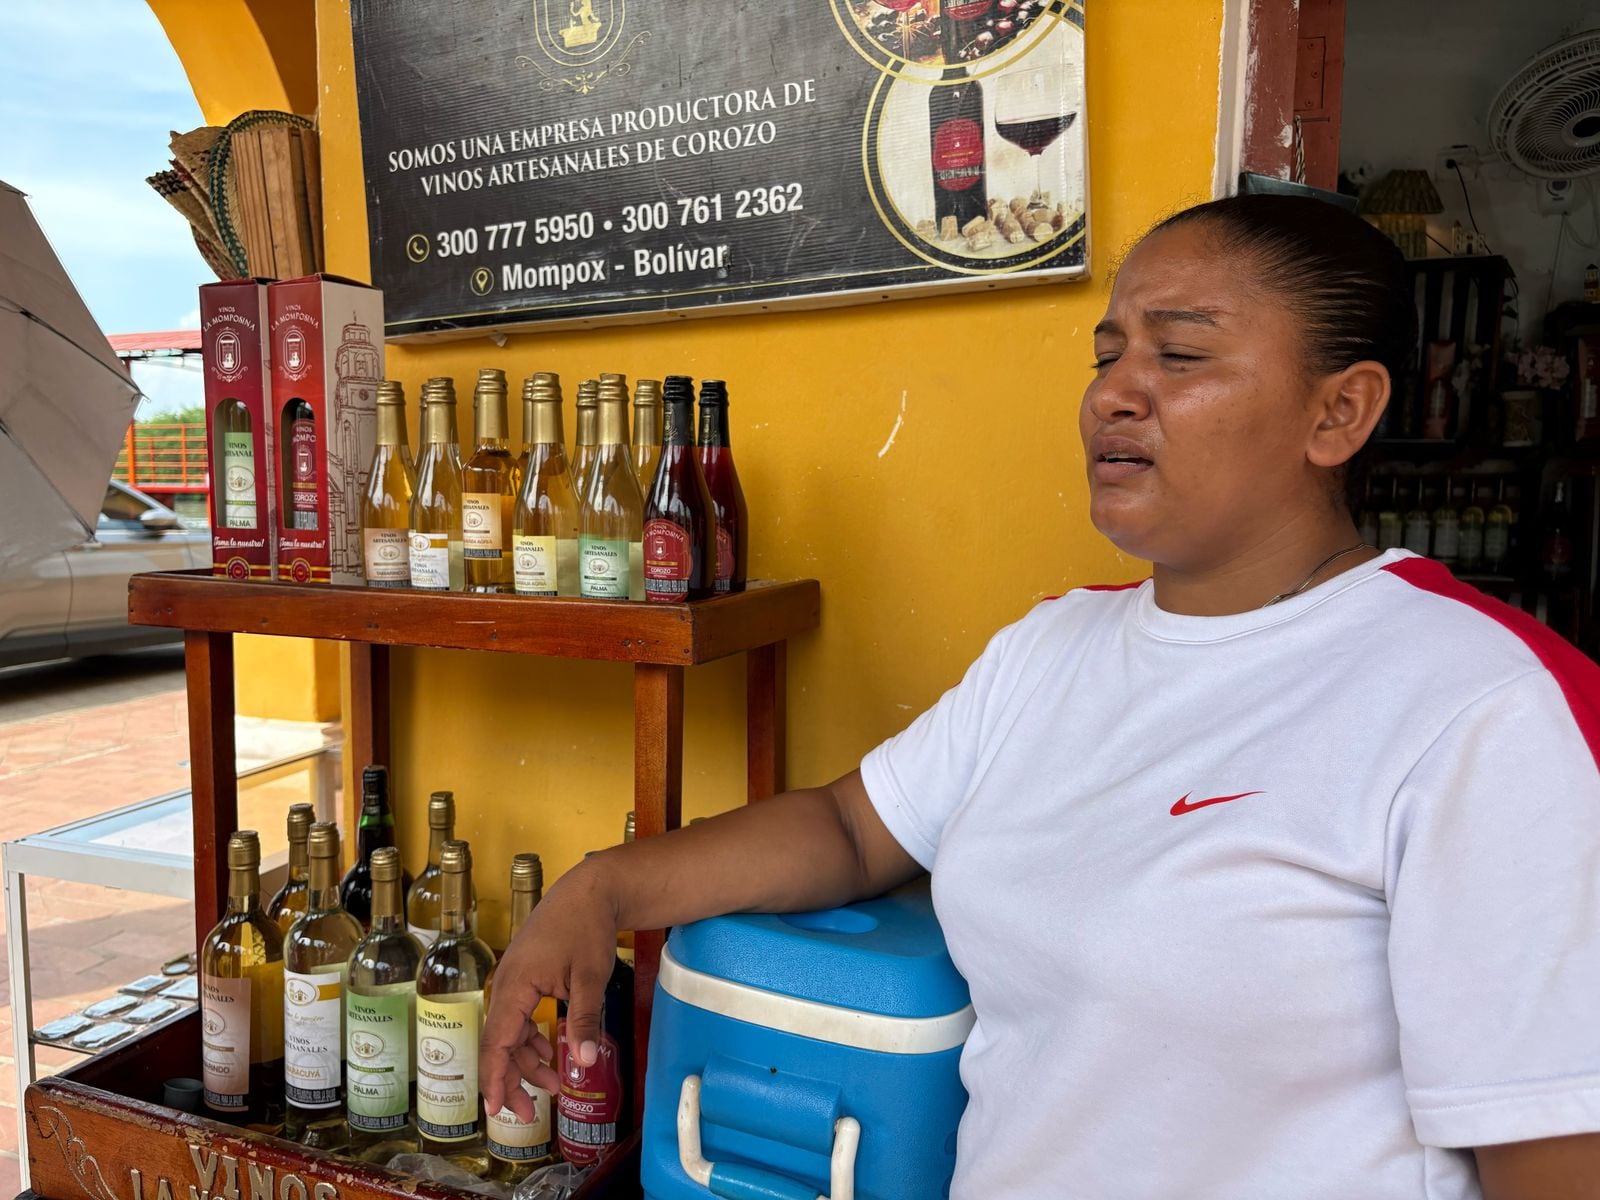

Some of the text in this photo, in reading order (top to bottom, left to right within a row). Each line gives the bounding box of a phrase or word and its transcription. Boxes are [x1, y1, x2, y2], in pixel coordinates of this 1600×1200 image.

[388, 79, 816, 172] SOMOS UNA EMPRESA PRODUCTORA DE
[421, 120, 777, 196] VINOS ARTESANALES DE COROZO
[437, 228, 478, 258] 300
[485, 221, 527, 252] 777
[534, 212, 594, 245] 5950
[621, 203, 669, 233] 300
[676, 195, 723, 227] 761
[735, 183, 804, 219] 2362
[502, 259, 605, 291] Mompox
[634, 243, 728, 278] Bolívar
[285, 304, 302, 312] VINOS
[203, 313, 256, 332] LA MOMPOSINA
[271, 312, 319, 331] LA MOMPOSINA
[229, 519, 251, 527] PALMA
[650, 567, 672, 575] COROZO
[354, 1004, 376, 1014] VINOS
[423, 1009, 447, 1021] VINOS
[348, 1010, 393, 1023] RTESANALES
[289, 1034, 311, 1045] VINOS
[353, 1084, 379, 1096] PALMA
[560, 1096, 594, 1113] COROZO
